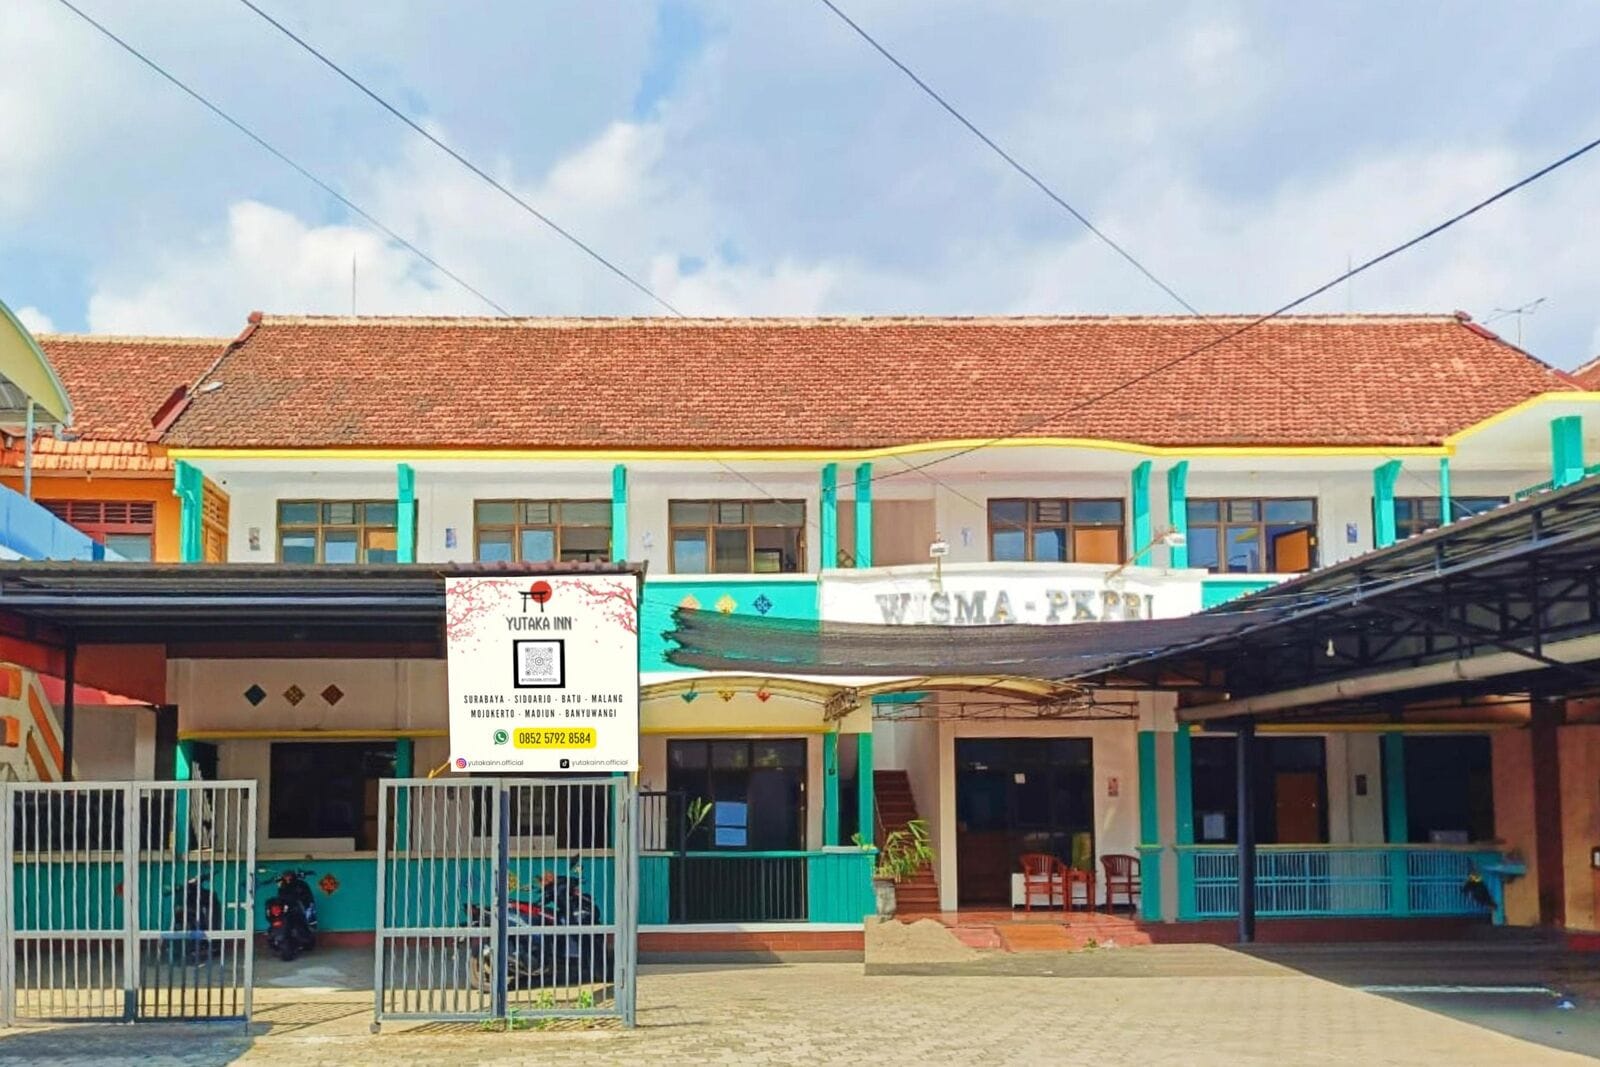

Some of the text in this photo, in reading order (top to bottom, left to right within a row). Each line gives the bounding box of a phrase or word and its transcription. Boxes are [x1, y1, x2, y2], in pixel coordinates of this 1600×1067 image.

[875, 590, 1017, 625] WISMA
[1046, 589, 1154, 622] PKPRI
[506, 616, 572, 631] YUTAKA INN
[463, 695, 505, 704] SURABAYA
[514, 694, 552, 704] SIDOARJO
[561, 694, 581, 703] BATU
[591, 694, 623, 703] MALANG
[470, 709, 515, 718] MOJOKERTO
[524, 709, 555, 718] MADIUN
[565, 708, 617, 718] BANYUWANGI
[519, 732, 591, 744] 0852 5792 8584
[468, 758, 524, 768] yutakainn.official
[571, 758, 629, 767] yutakainn.official
